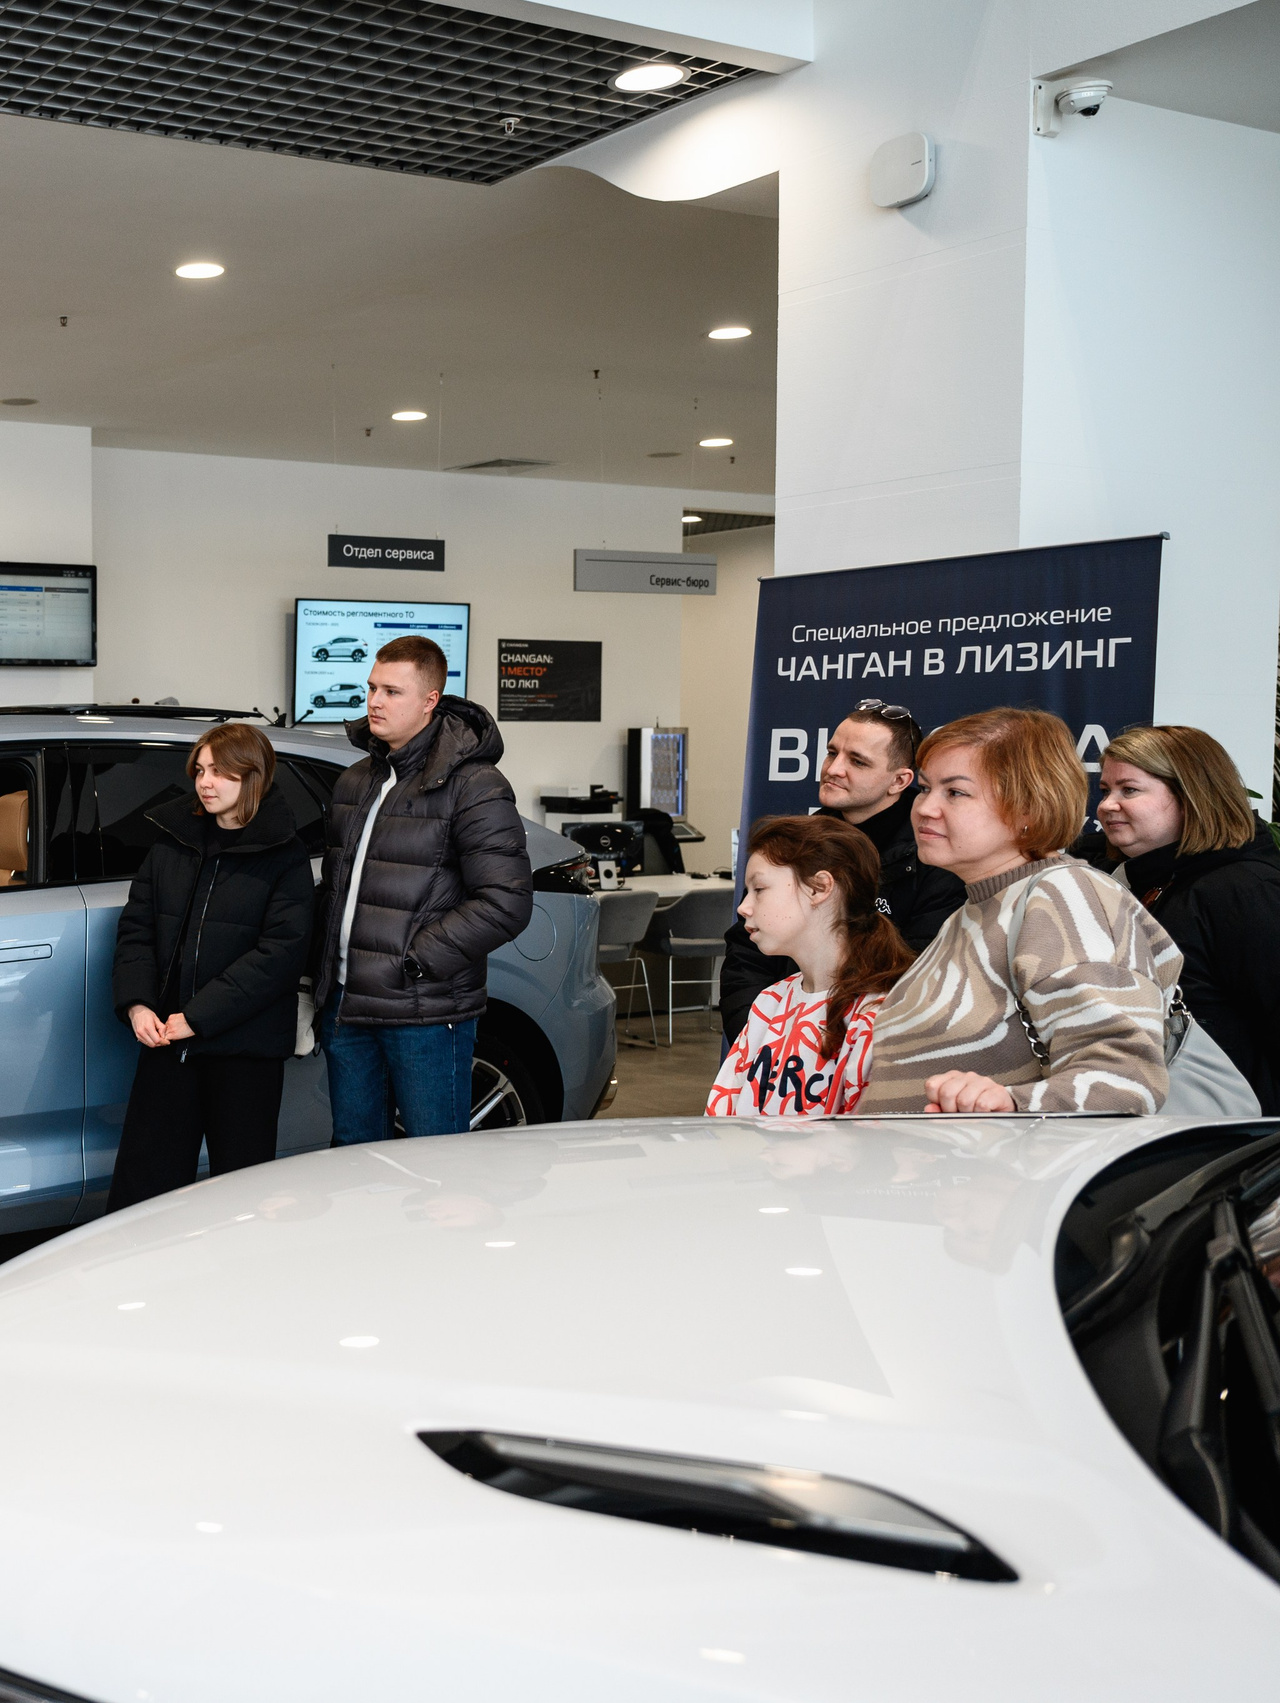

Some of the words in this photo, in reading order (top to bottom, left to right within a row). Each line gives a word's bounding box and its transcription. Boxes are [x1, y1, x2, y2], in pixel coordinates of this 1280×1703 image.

[343, 544, 381, 560] Отдел
[384, 547, 435, 561] сервиса
[649, 574, 710, 590] Сервис-бюро
[303, 608, 345, 618] Стоимость
[347, 610, 404, 619] регламентного
[405, 611, 415, 619] ТО
[792, 618, 932, 644] Специальное
[938, 605, 1112, 637] предложение
[500, 653, 554, 664] CHANGAN:
[777, 650, 912, 682] ЧАНГАН
[923, 648, 946, 676] В
[955, 637, 1133, 675] ЛИЗИНГ
[501, 666, 506, 676] 1
[500, 679, 516, 689] ПО
[517, 679, 539, 689] ЛКП
